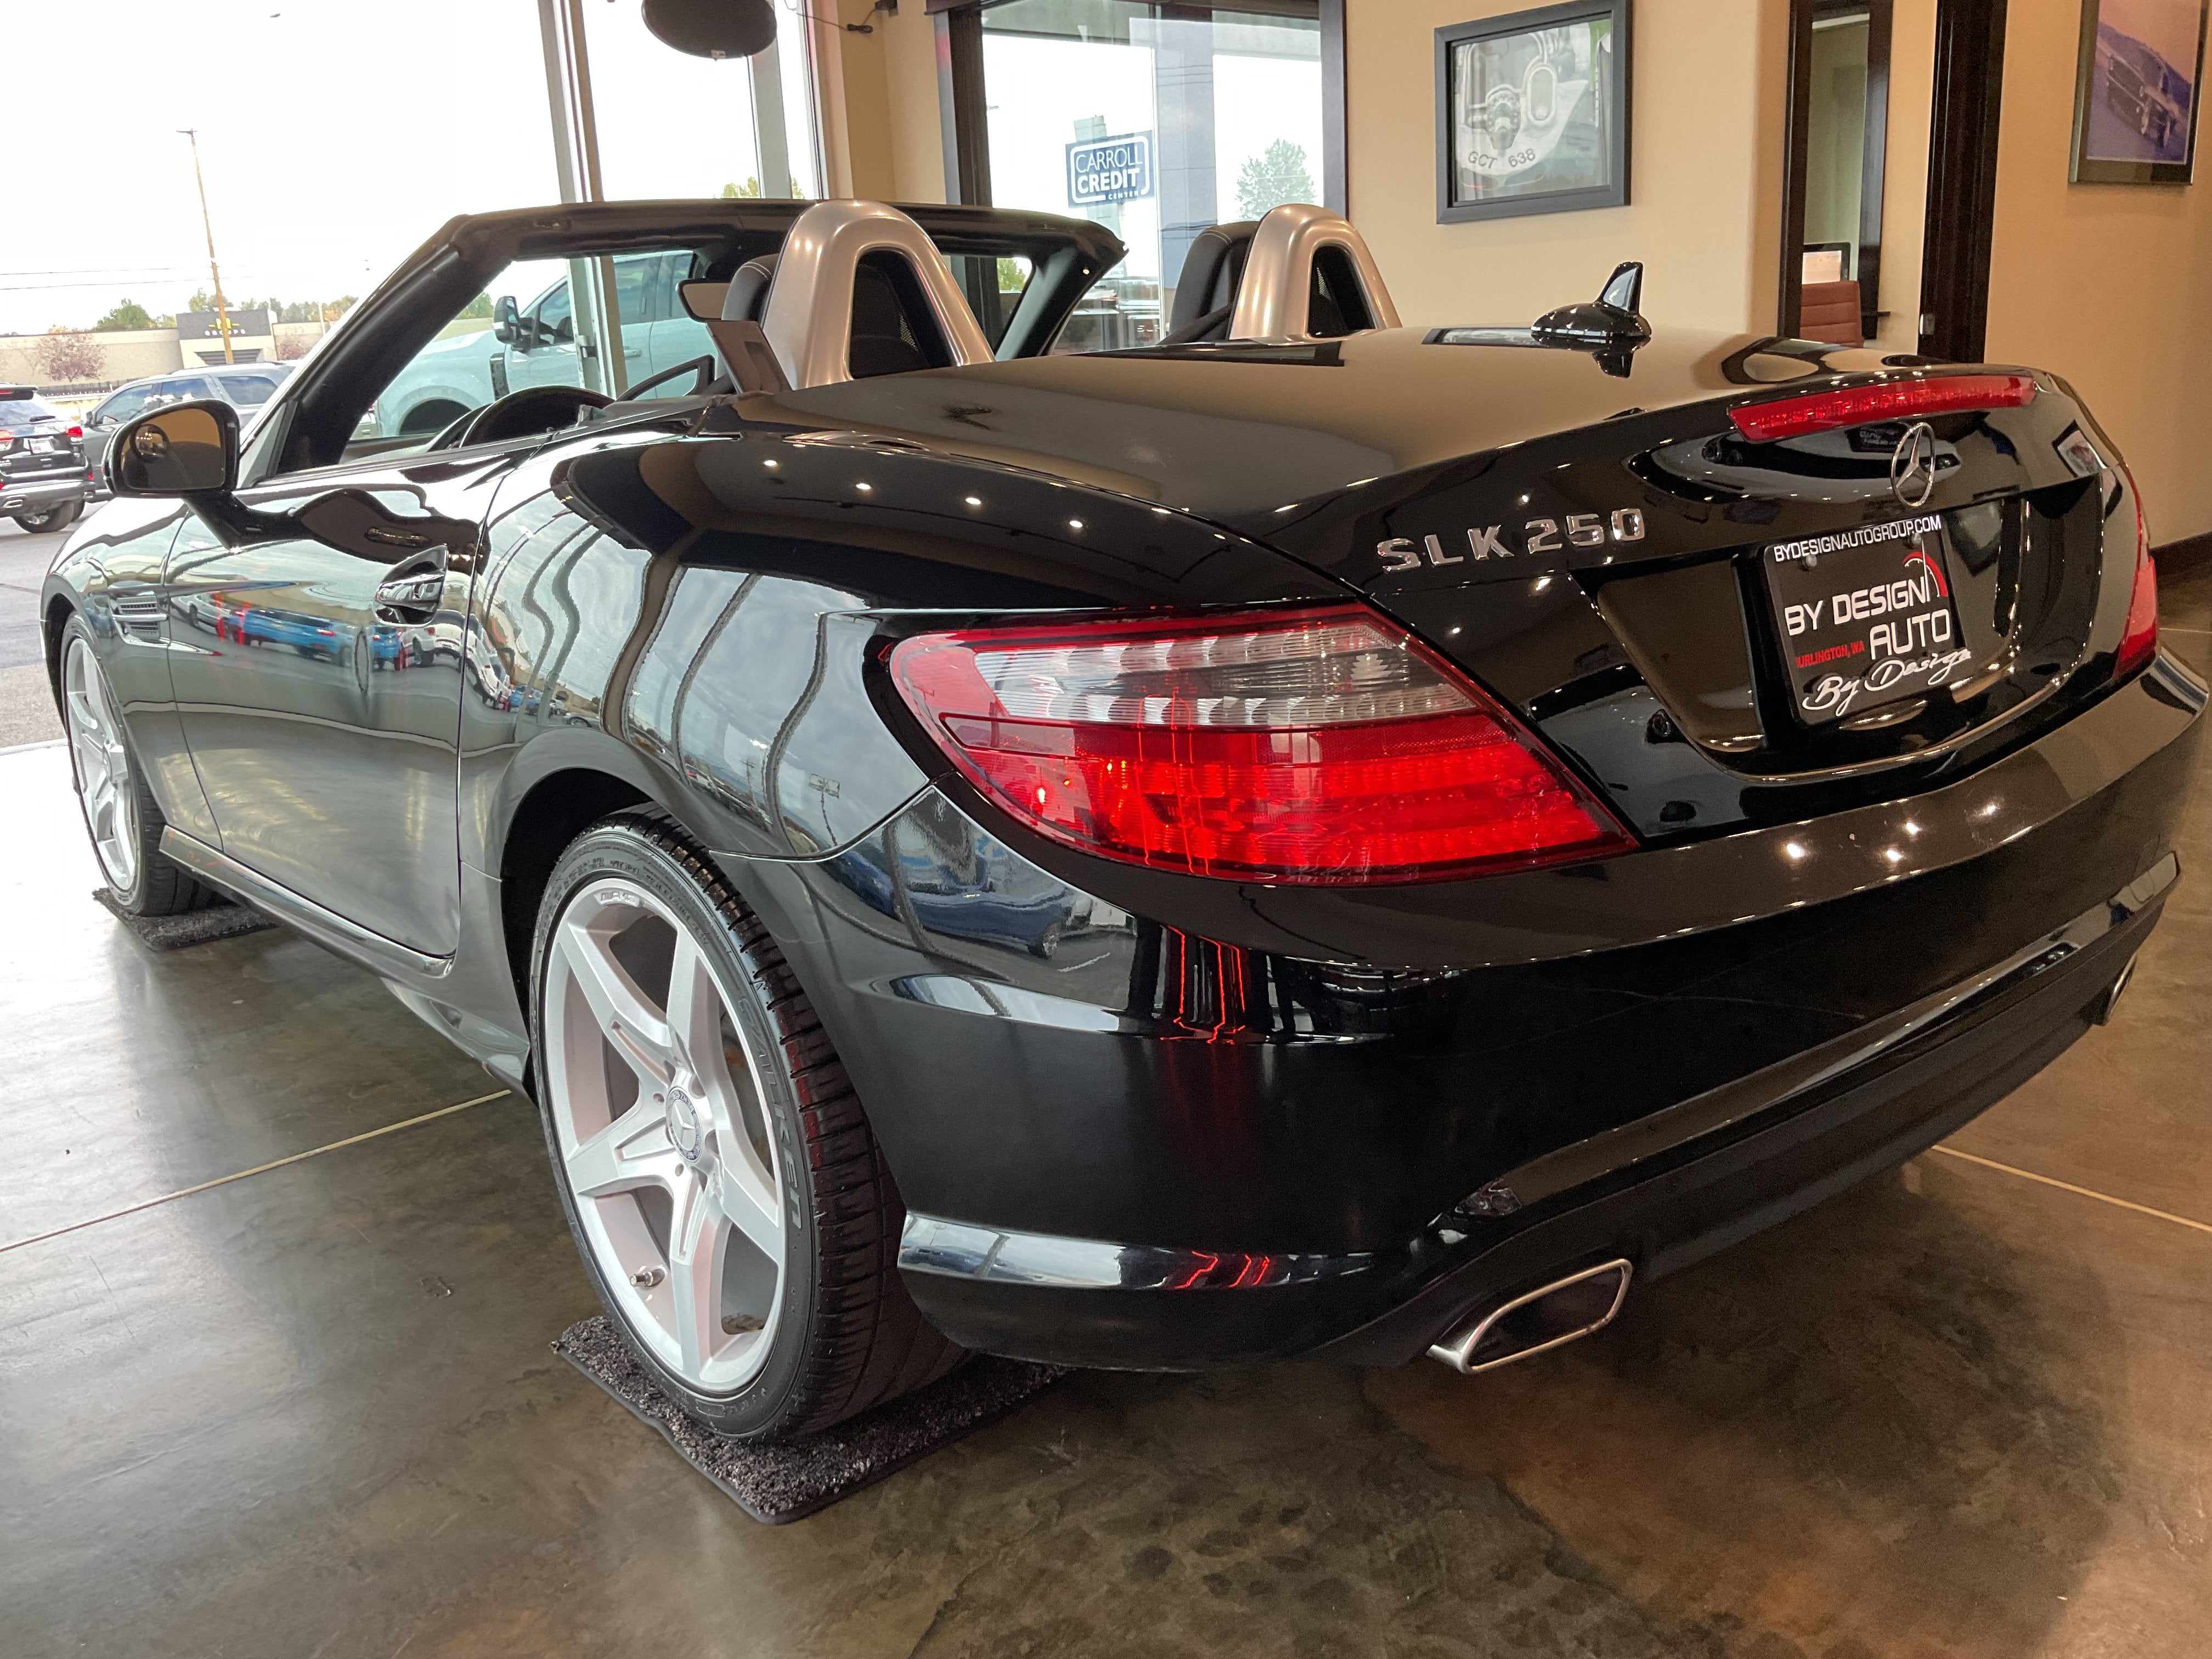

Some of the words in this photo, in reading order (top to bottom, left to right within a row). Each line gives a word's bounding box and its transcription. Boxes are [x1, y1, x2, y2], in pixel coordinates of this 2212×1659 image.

[1076, 146, 1143, 173] CARROLL
[1468, 151, 1498, 169] GCT
[1509, 148, 1536, 167] 638
[1077, 168, 1140, 194] CREDIT
[1108, 190, 1139, 200] CENTER
[1376, 525, 1514, 572] SLK
[1525, 507, 1646, 555] 250
[1773, 515, 1942, 562] BYDESIGNAUTOGROUP.COM
[1784, 600, 1824, 636] BY
[1832, 576, 1927, 625] DESIGN
[1869, 608, 1951, 660] AUTO
[1795, 644, 1850, 668] URLINGTON,
[1850, 640, 1865, 654] WA
[1802, 676, 1860, 716] By
[1864, 648, 1971, 691] Design
